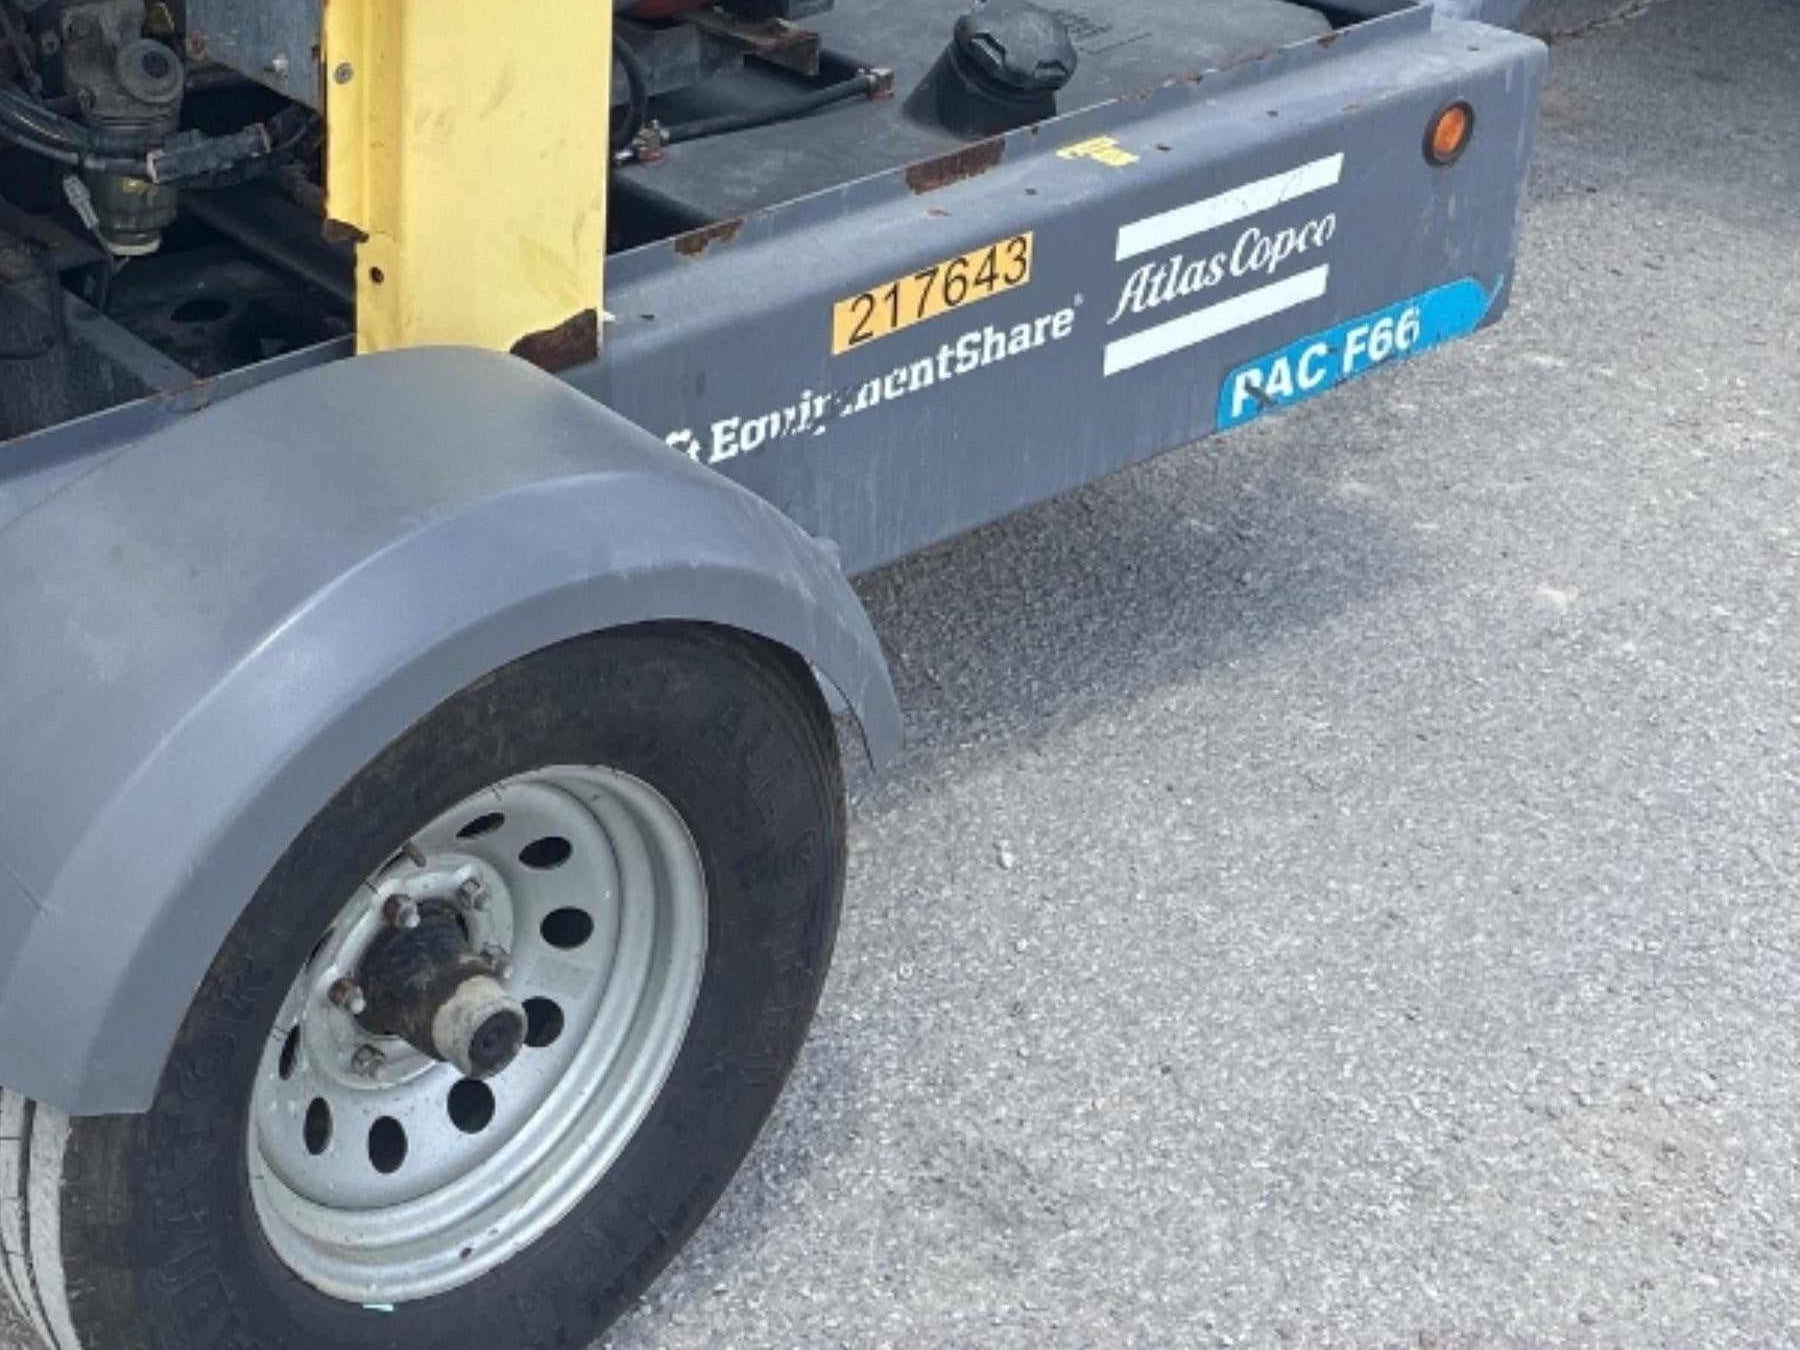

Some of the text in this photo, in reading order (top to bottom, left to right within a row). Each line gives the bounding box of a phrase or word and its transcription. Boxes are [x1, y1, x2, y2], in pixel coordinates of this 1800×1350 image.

[849, 236, 1029, 345] 217643
[1106, 211, 1337, 325] Atlas Copco
[1342, 305, 1421, 374] F66
